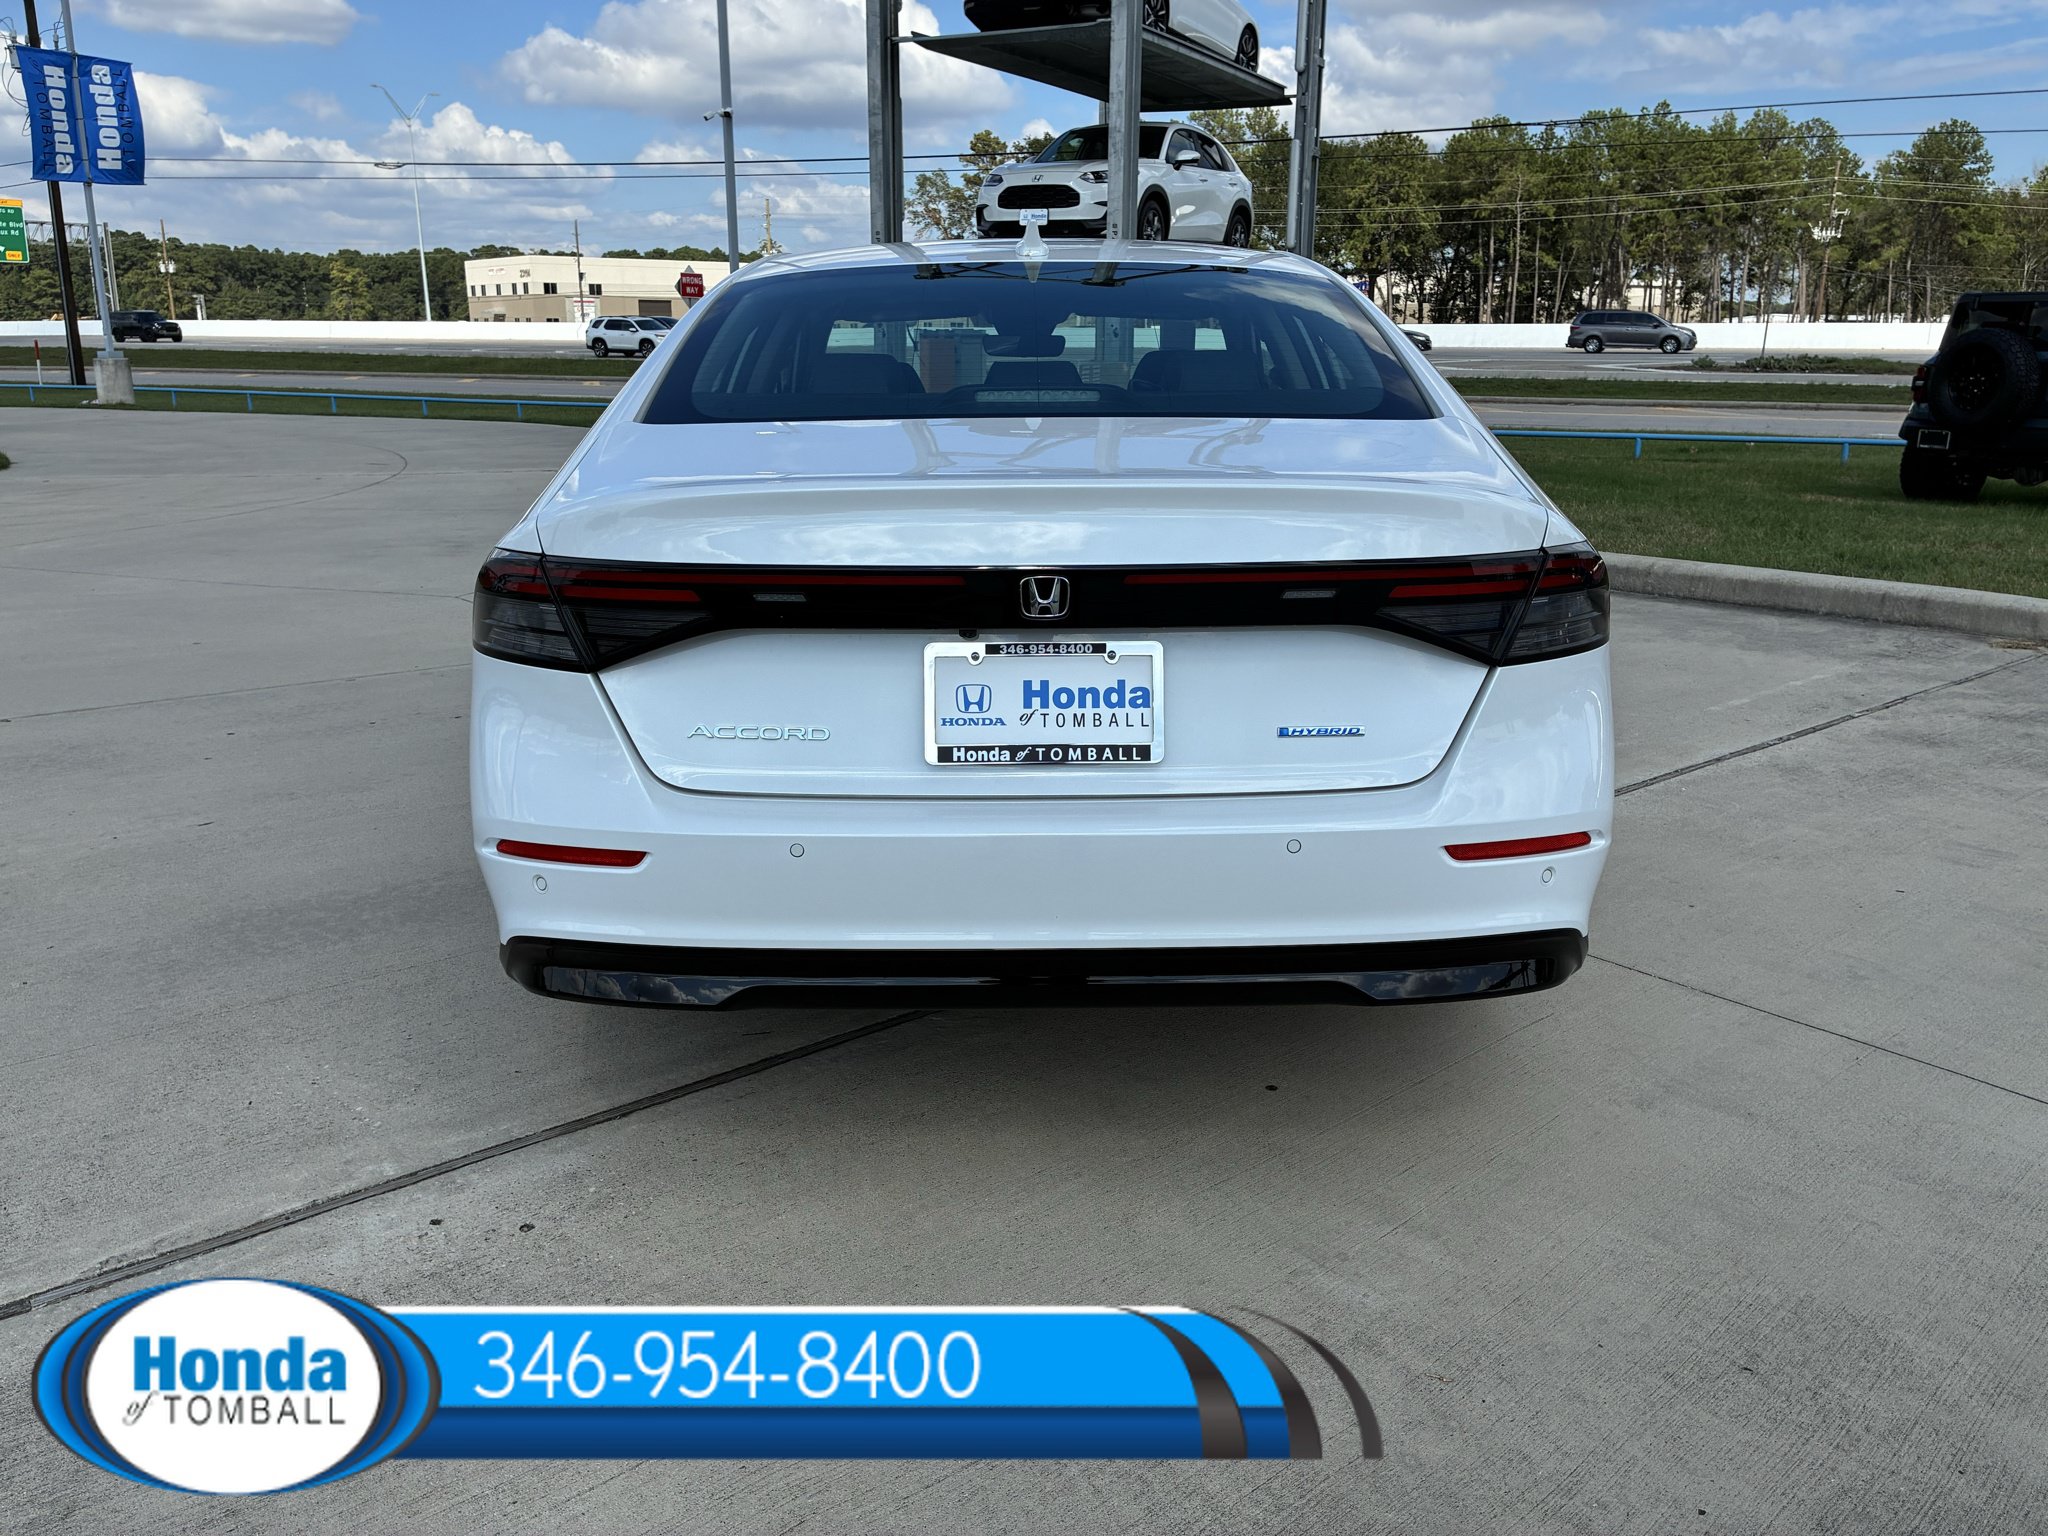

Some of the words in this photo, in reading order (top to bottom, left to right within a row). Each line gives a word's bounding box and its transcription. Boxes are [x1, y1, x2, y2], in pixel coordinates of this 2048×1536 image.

[43, 65, 75, 174] Honda
[89, 64, 122, 170] Honda
[112, 69, 135, 156] TOMBALL
[33, 80, 55, 171] TOMBALL
[682, 276, 703, 285] WRONG
[686, 286, 699, 294] WAY
[1000, 644, 1093, 654] 346-954-8400
[1022, 679, 1151, 709] Honda
[940, 717, 1007, 727] HONDA
[1019, 709, 1039, 726] of
[1039, 712, 1150, 728] TOMBALL
[687, 725, 831, 741] ACCORD
[1289, 727, 1361, 737] HYBRID
[952, 747, 1011, 762] Honda
[1015, 746, 1032, 761] of
[1036, 748, 1142, 761] TOMBALL
